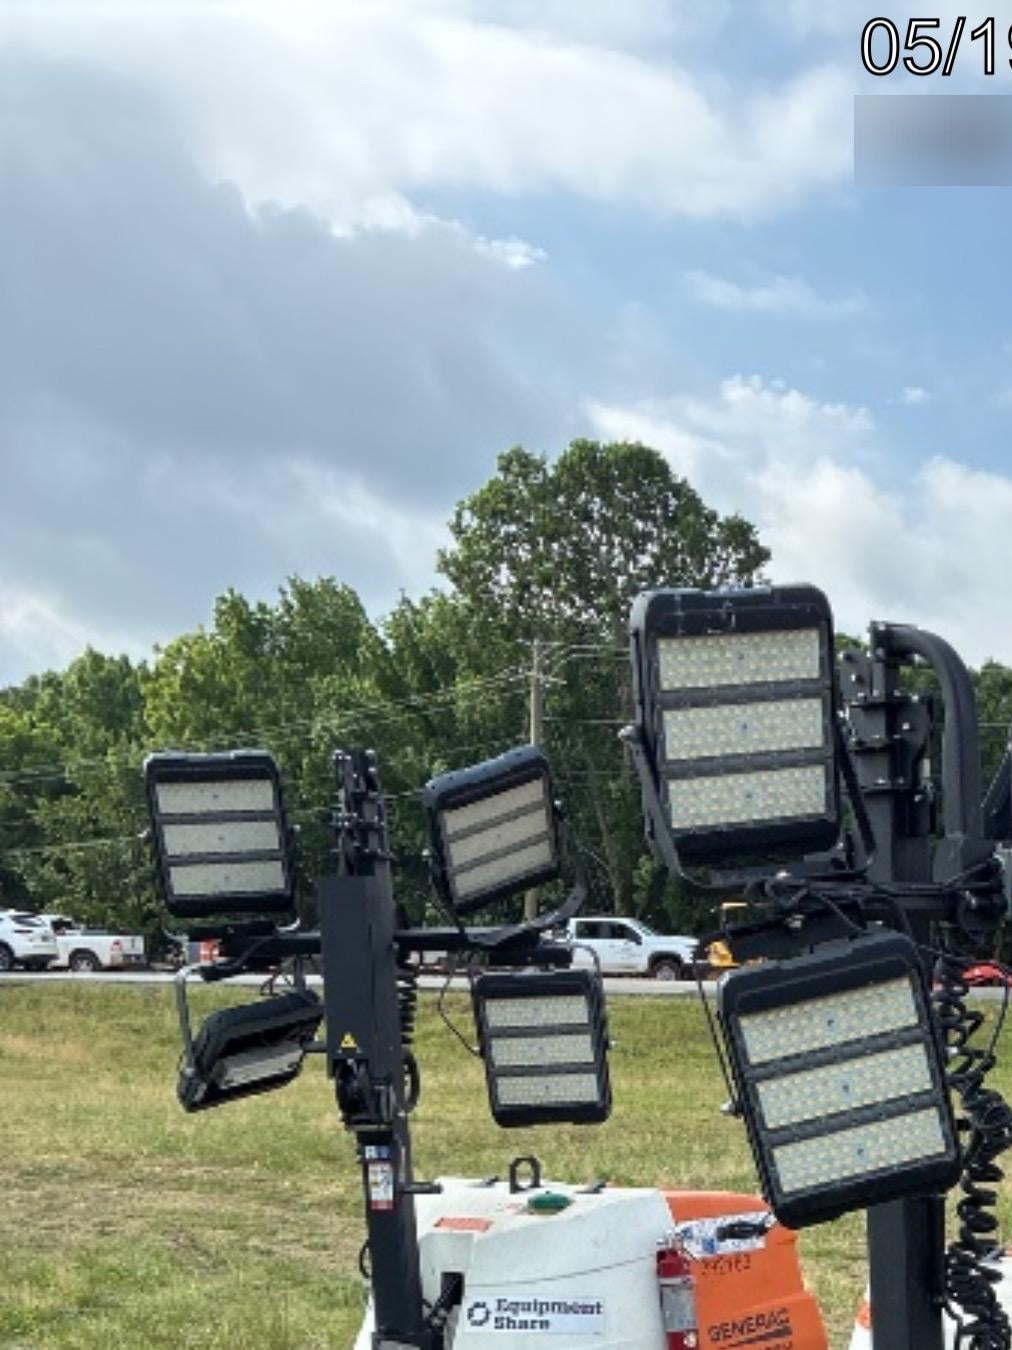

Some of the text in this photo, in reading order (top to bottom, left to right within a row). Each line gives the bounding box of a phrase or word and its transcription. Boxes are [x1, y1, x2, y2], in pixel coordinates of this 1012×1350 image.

[494, 1297, 604, 1317] Equipment
[494, 1316, 551, 1331] Share
[707, 1307, 790, 1344] GENERAC
